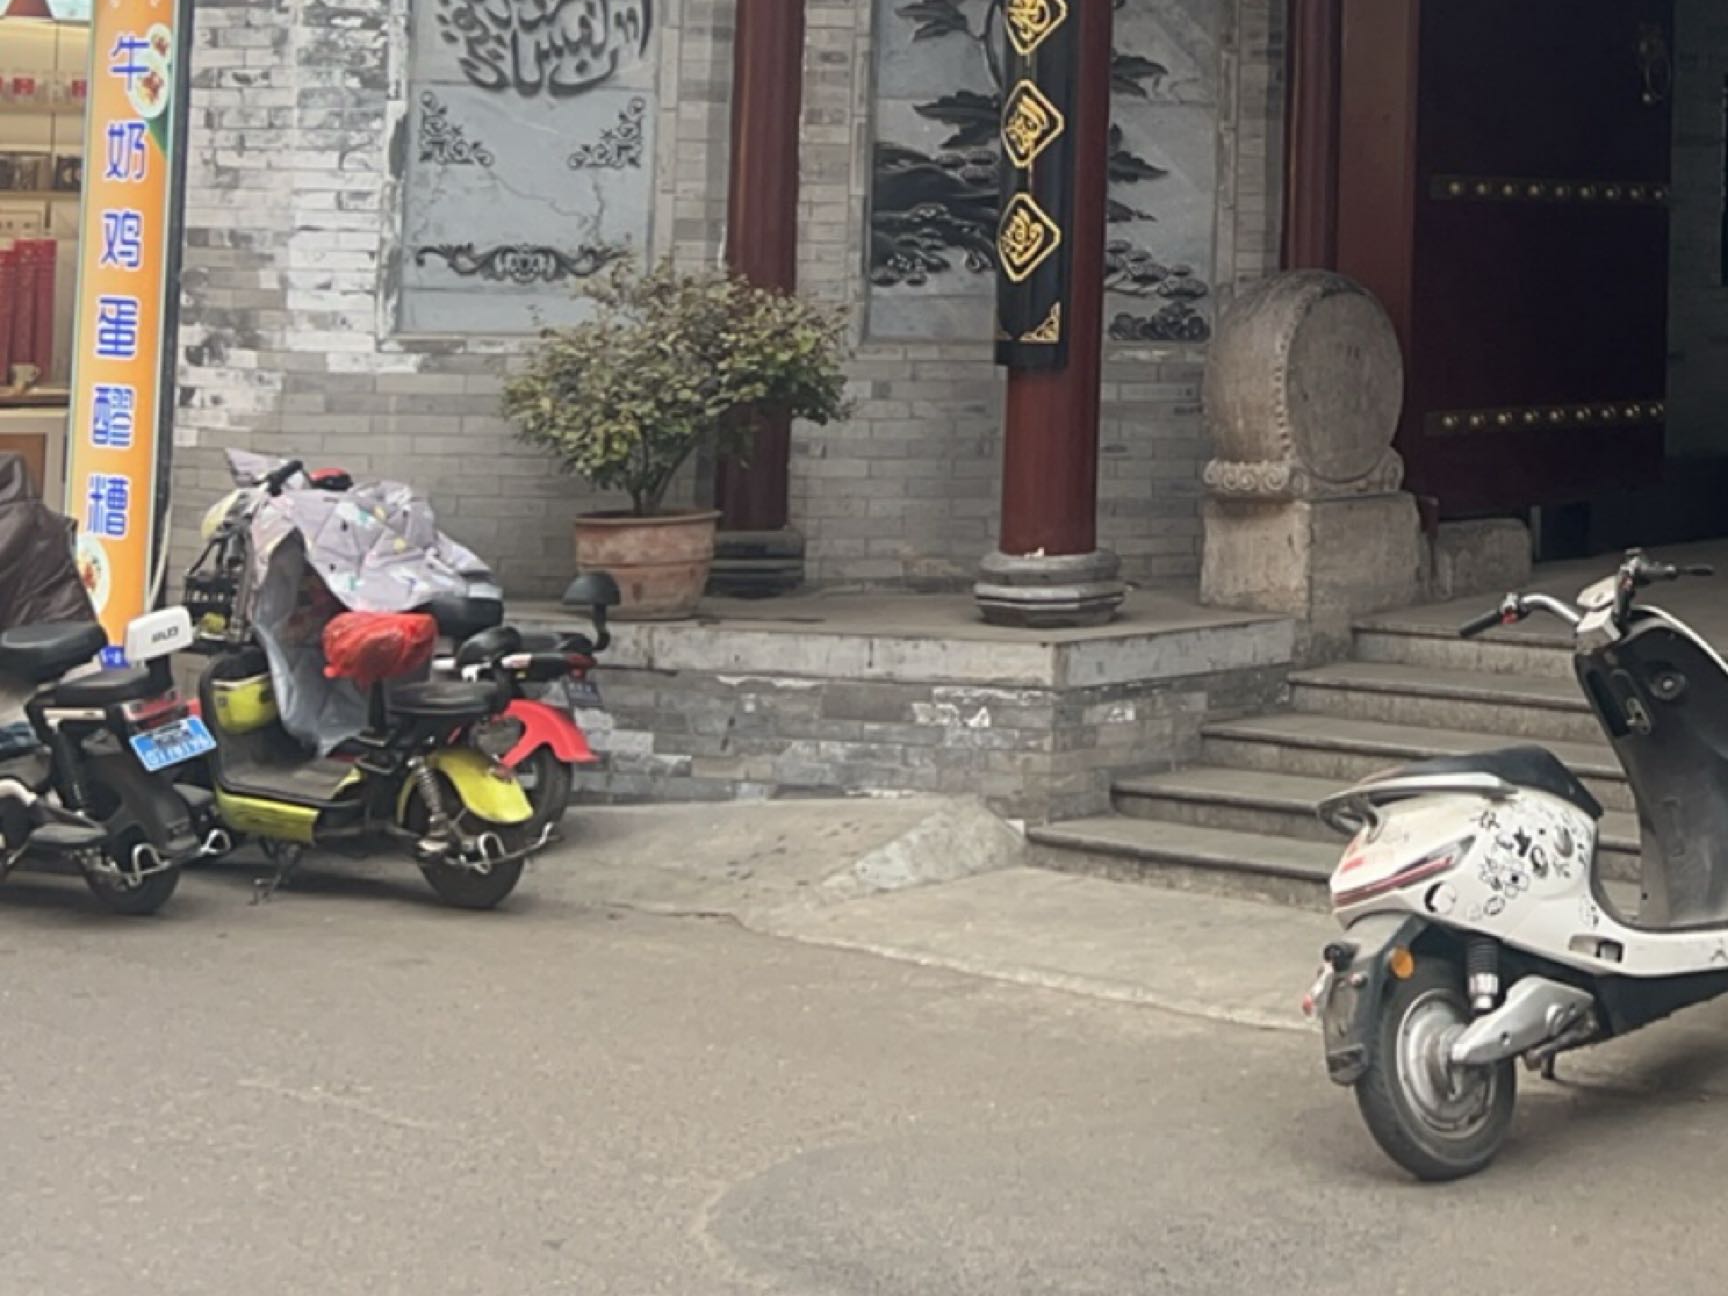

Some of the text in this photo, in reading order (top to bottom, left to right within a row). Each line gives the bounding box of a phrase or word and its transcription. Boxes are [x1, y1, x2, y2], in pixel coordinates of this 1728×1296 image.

[87, 35, 151, 537] 牛奶鸡蛋醪糟
